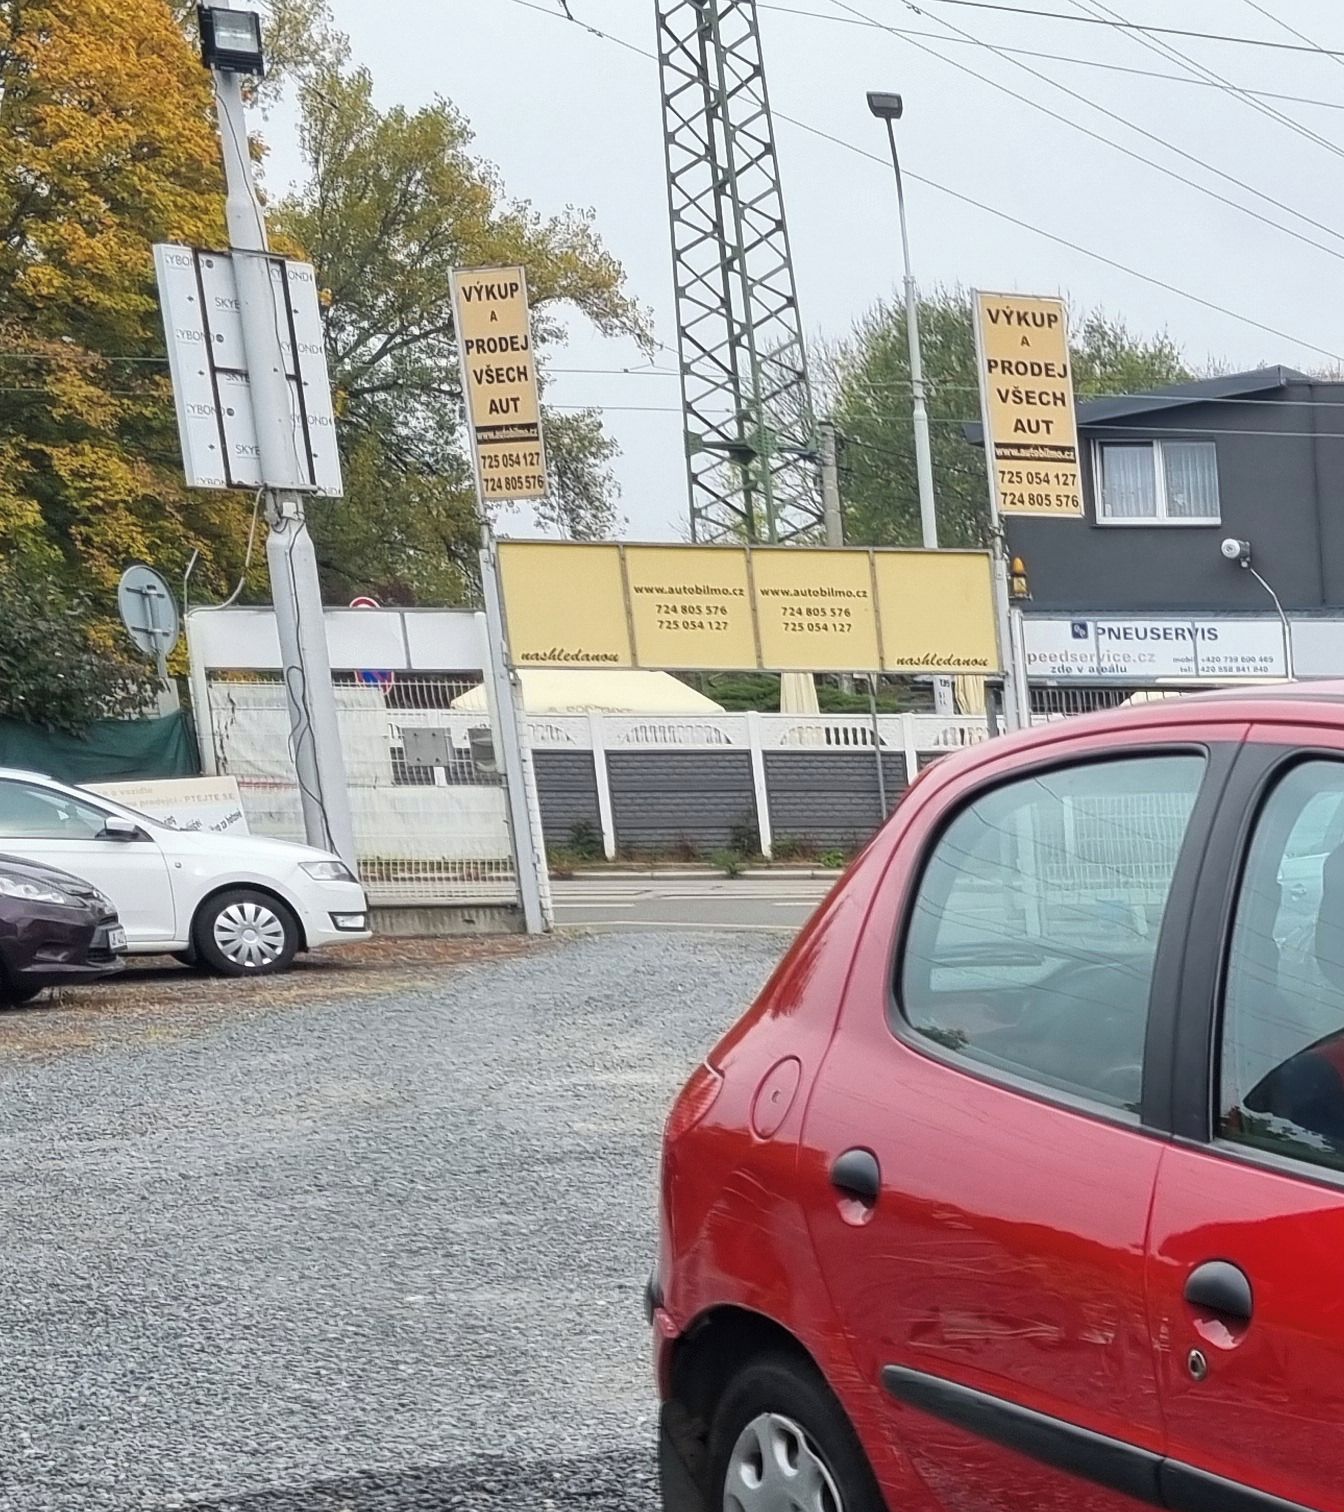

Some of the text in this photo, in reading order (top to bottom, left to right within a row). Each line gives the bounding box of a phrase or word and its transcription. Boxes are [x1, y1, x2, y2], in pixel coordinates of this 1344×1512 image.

[462, 281, 519, 302] VÝKUP
[490, 310, 498, 322] A
[987, 305, 1059, 328] VÝKUP
[465, 335, 529, 355] PRODEJ
[1020, 335, 1031, 347] A
[473, 364, 528, 385] VŠECH
[987, 358, 1068, 379] PRODEJ
[996, 386, 1067, 407] VŠECH
[489, 397, 520, 415] AUT
[1013, 418, 1054, 435] AUT
[481, 452, 540, 469] 725 054 127
[483, 474, 544, 492] 724 805 576
[998, 470, 1077, 486] 725 054 127
[1001, 492, 1079, 508] 724 805 576
[633, 584, 745, 597] www.autobilmo.cz
[760, 586, 868, 599] www.autobilmo.cz
[656, 604, 728, 616] 724 805 576
[781, 606, 851, 618] 724 805 576
[657, 620, 729, 631] 725 054 127
[783, 622, 852, 633] 725 054 127
[1096, 627, 1219, 641] PNEUSERVIS
[521, 648, 619, 663] nashledanou
[896, 653, 989, 667] nashledanou
[1027, 650, 1156, 665] peedservice.cz
[1050, 664, 1073, 674] zde
[1076, 666, 1084, 674] v
